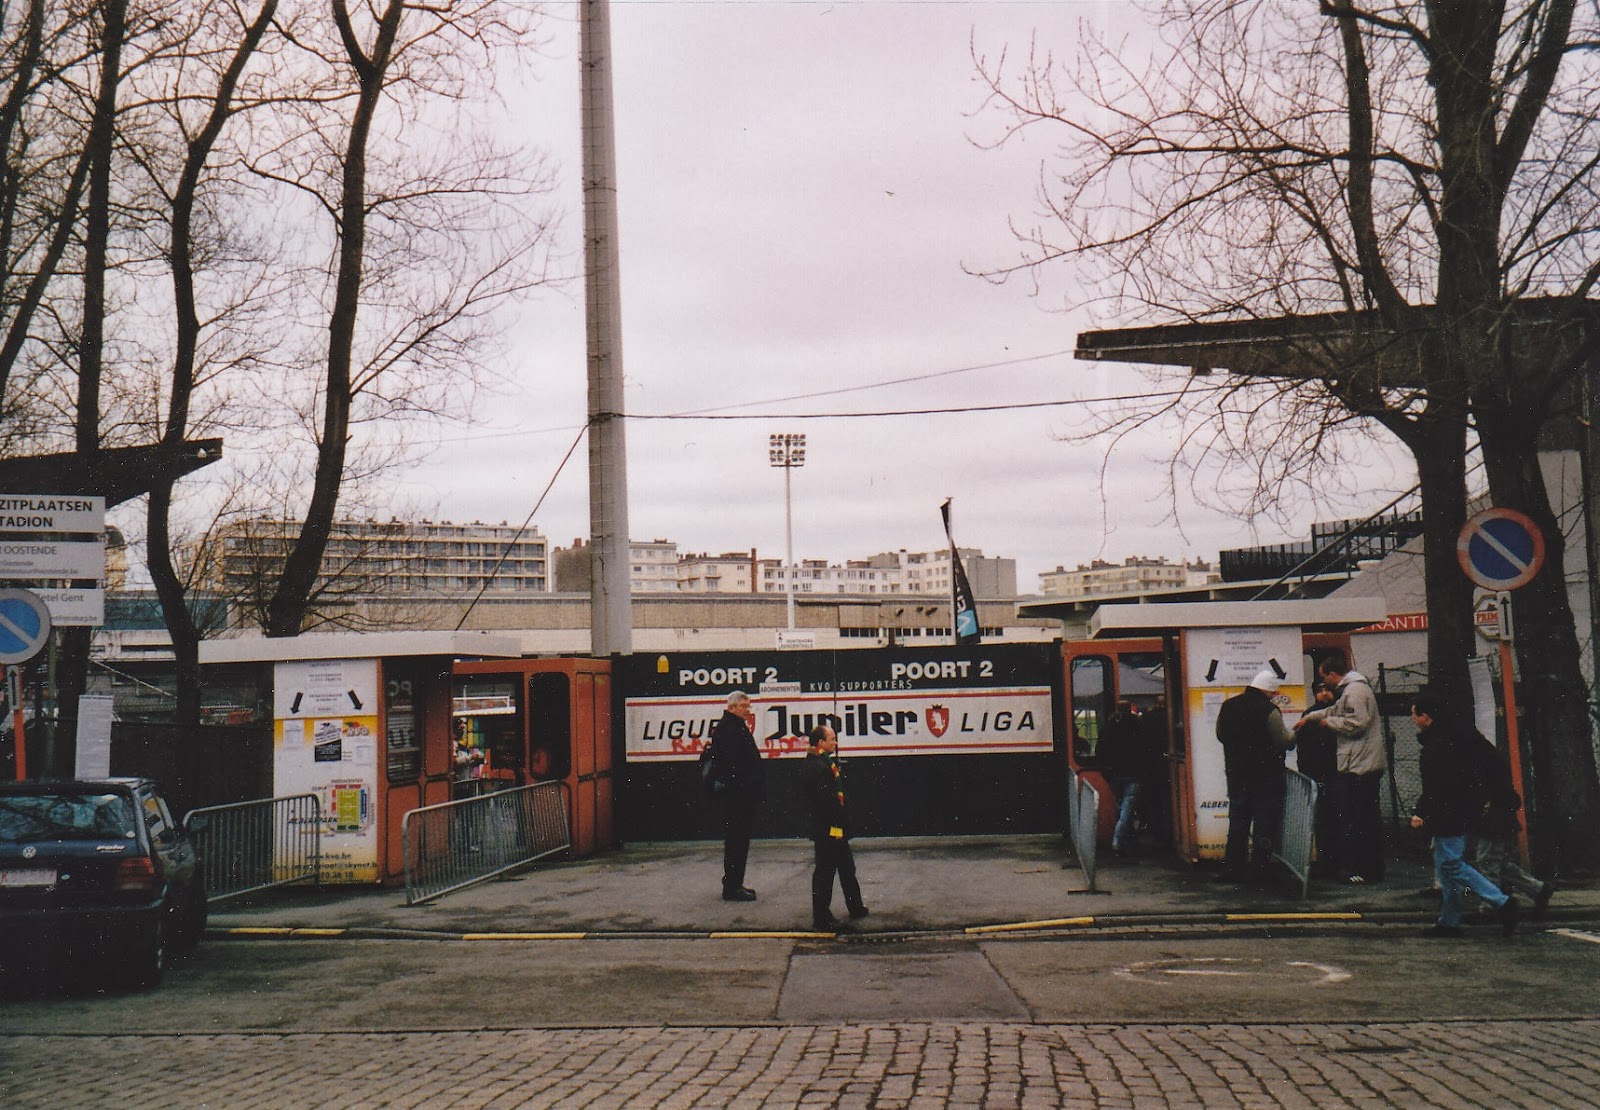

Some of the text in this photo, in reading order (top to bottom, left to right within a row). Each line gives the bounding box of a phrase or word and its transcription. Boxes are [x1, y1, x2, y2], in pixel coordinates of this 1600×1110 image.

[0, 516, 53, 527] TADION
[4, 546, 57, 555] OOSTENDE
[60, 593, 84, 602] Gent
[679, 667, 778, 686] POORT 2
[891, 660, 994, 681] POORT 2
[809, 679, 913, 692] KVO SUPPORTERS
[960, 710, 1035, 732] LIGA
[1200, 800, 1230, 809] ALBER
